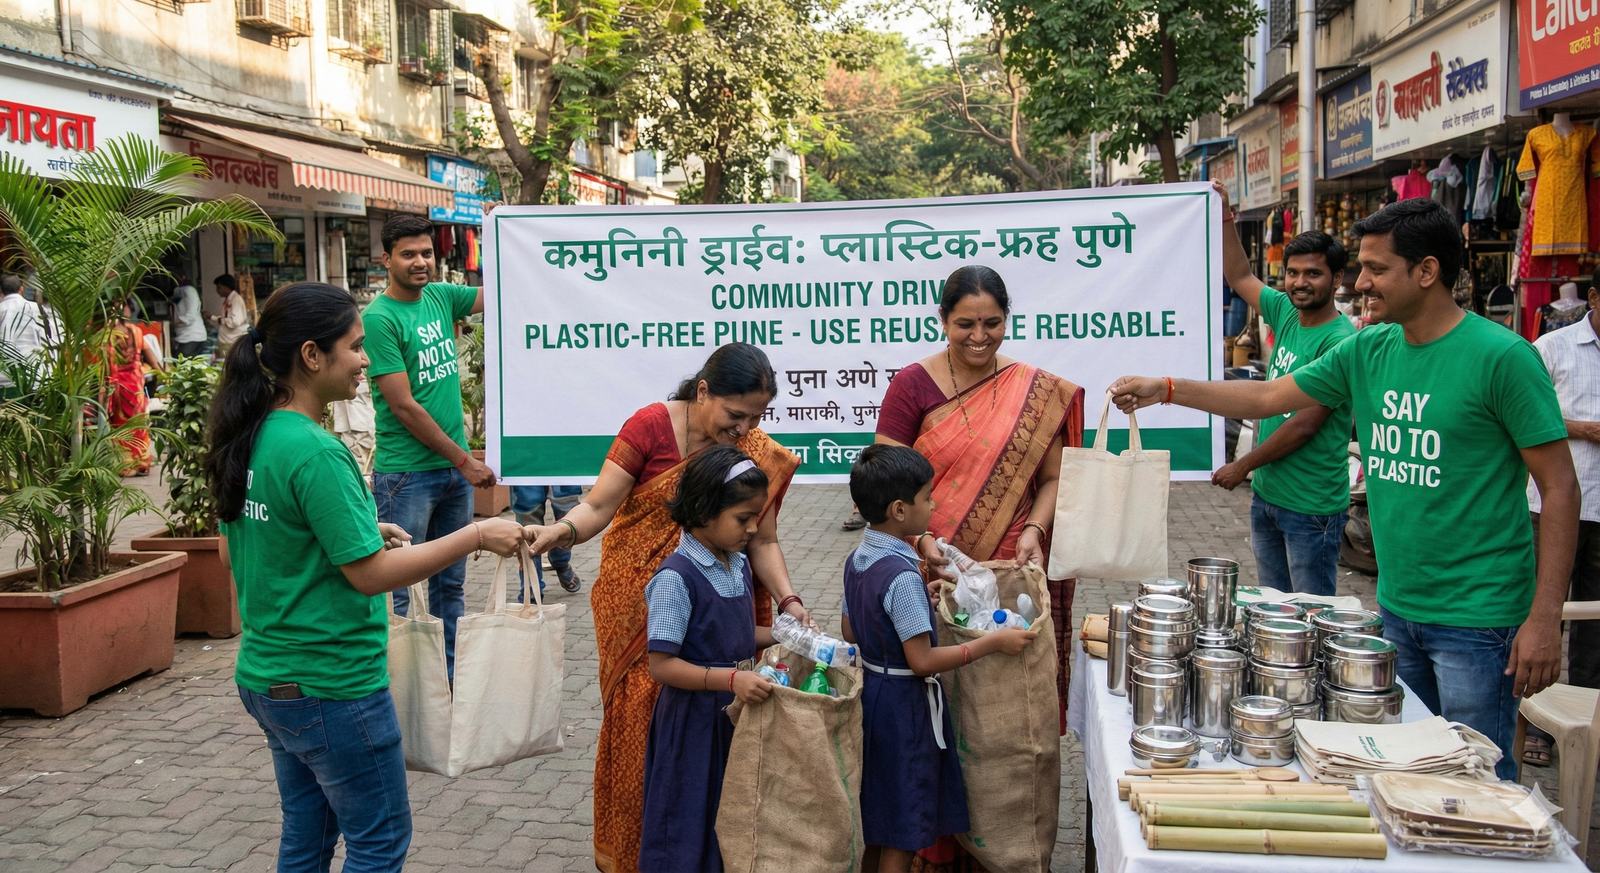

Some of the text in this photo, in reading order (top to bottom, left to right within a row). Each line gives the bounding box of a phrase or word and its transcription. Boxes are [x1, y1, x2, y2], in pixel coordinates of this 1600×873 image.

[542, 227, 688, 281] कमुनिनी
[700, 224, 805, 275] ड्राईव:
[1072, 211, 1137, 268] पुणे
[711, 279, 946, 310] COMMUNITY DRIV
[417, 319, 443, 345] SAY
[525, 321, 705, 350] PLASTIC-FREE
[714, 320, 783, 346] PUNE
[810, 318, 861, 345] USE
[1037, 310, 1185, 340] REUSABLE.
[418, 338, 455, 370] NO TO
[1274, 346, 1297, 374] SAY
[785, 369, 828, 397] पुना
[836, 360, 878, 389] अणे
[786, 400, 845, 423] माराकी,
[1382, 390, 1431, 422] SAY
[1370, 422, 1441, 461] NO TO
[1368, 455, 1441, 488] PLASTIC
